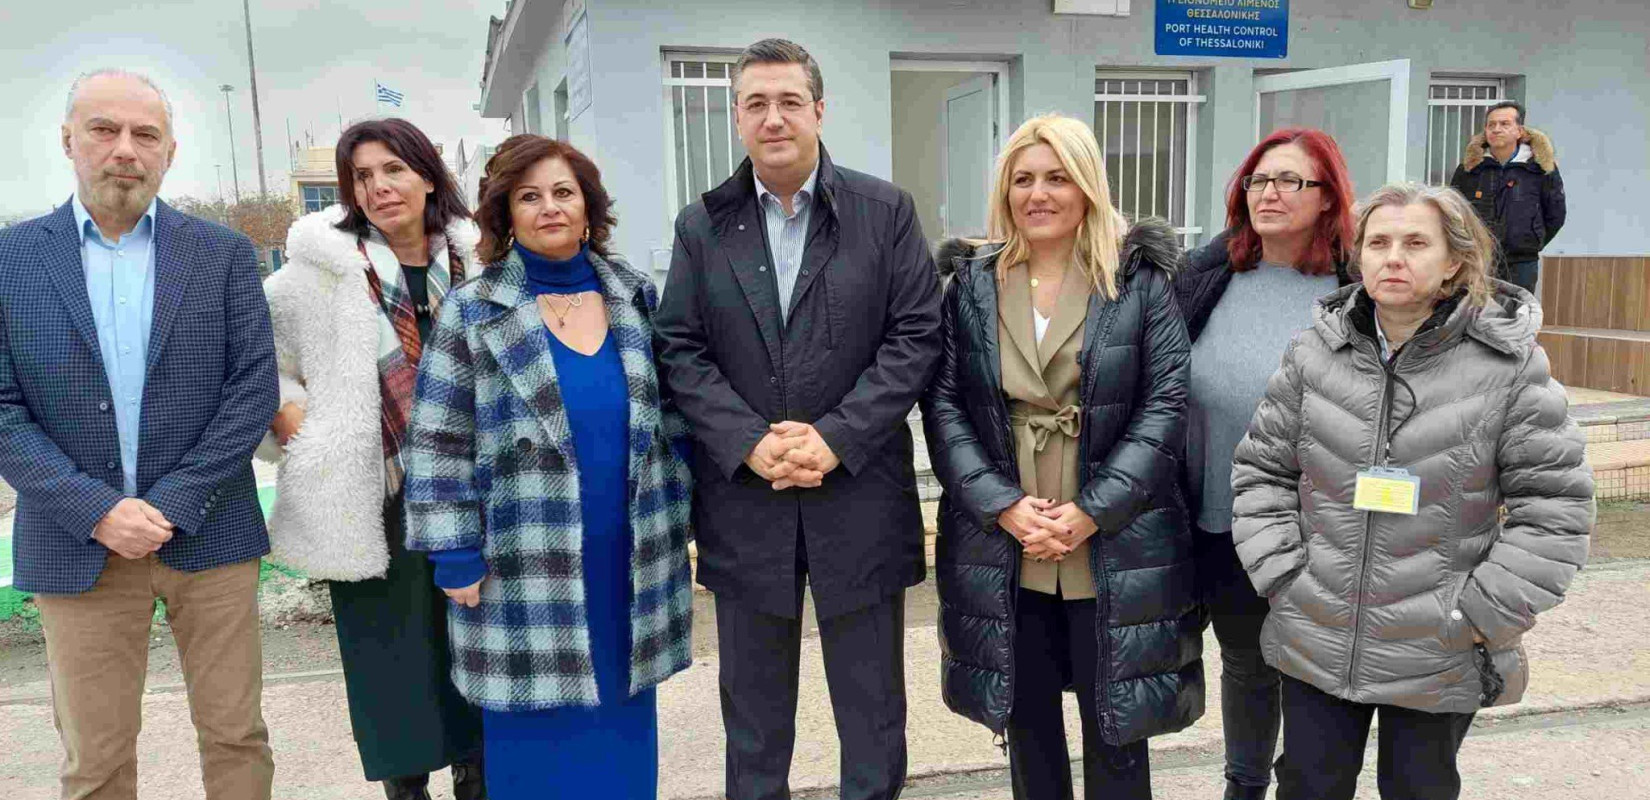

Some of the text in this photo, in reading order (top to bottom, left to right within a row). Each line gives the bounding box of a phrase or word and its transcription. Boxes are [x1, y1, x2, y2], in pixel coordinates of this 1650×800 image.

[1237, 0, 1280, 8] ΛΙΜΕΝΟΣ
[1186, 8, 1260, 20] ΘΕΣΣΑΛΟΝΙΚΗΣ
[1165, 23, 1278, 37] PORT HEALTH CONTROL
[1179, 37, 1264, 49] OF THESSALONIKI
